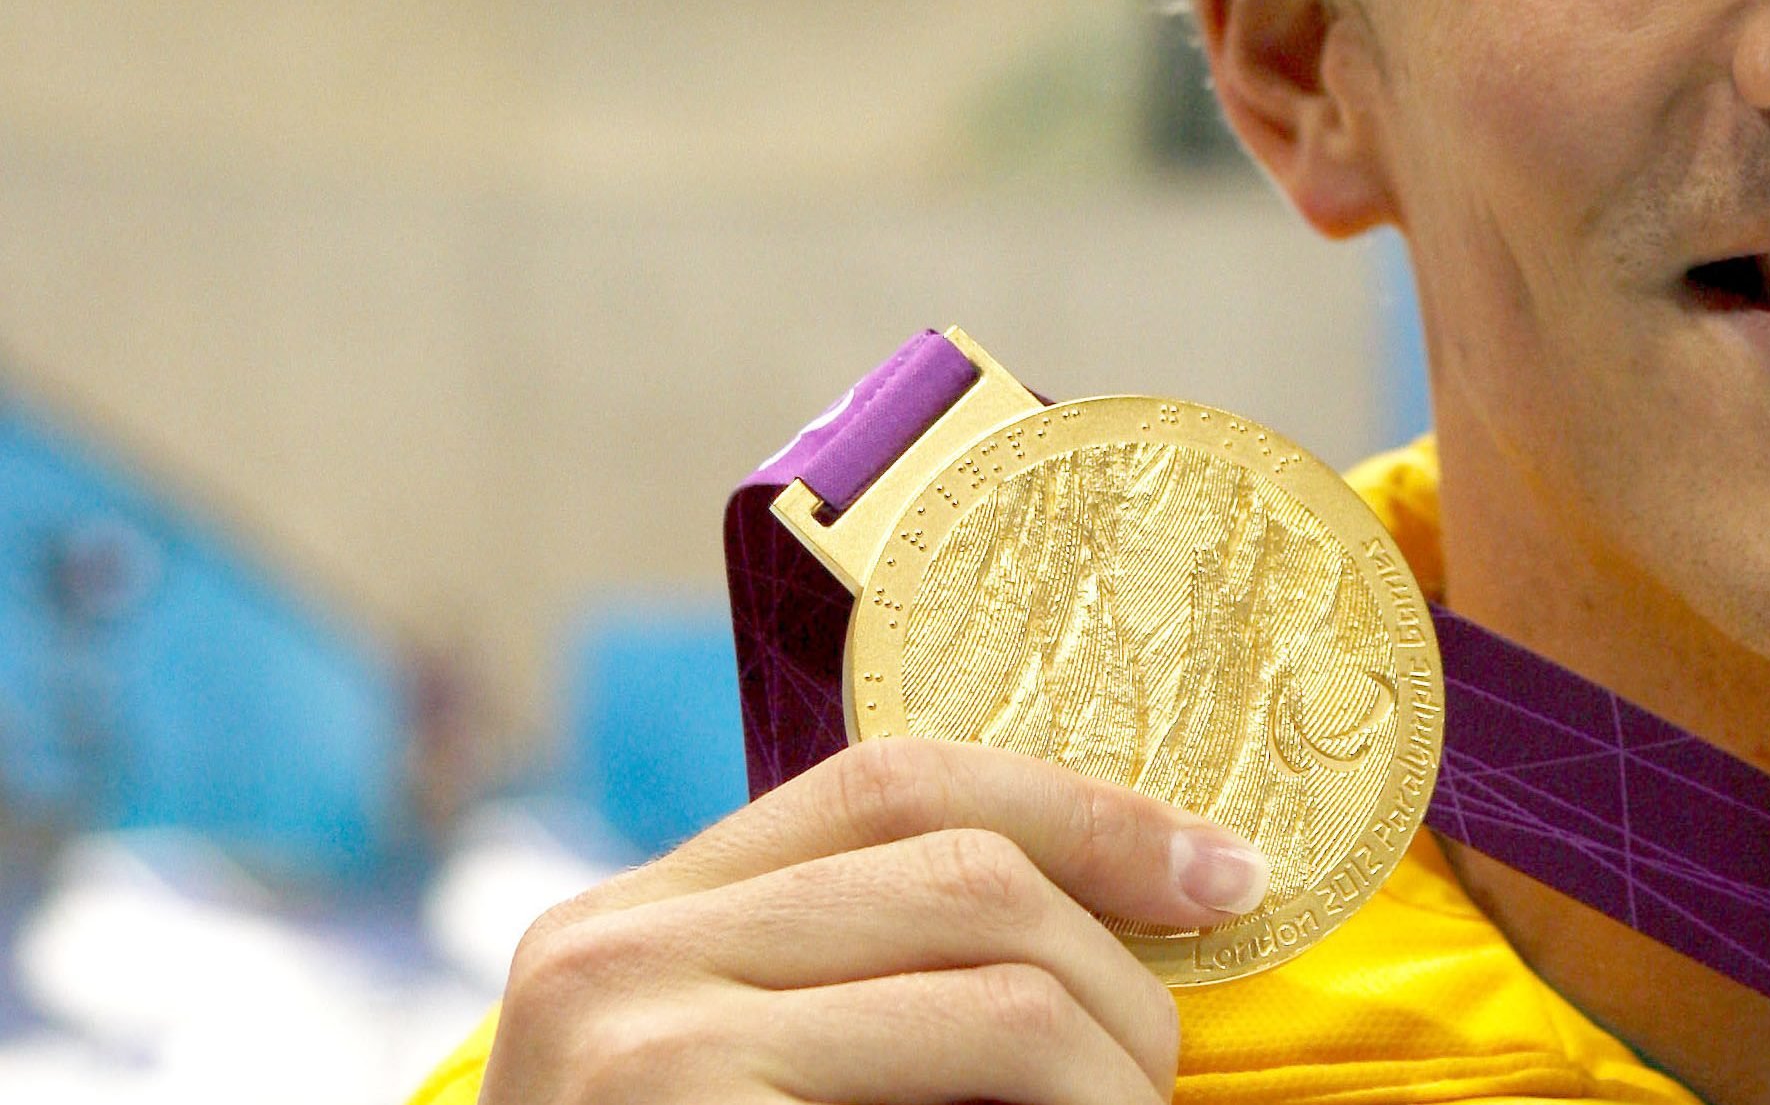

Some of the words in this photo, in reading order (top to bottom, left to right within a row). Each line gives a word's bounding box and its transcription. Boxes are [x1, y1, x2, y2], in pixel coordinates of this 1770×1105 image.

[1363, 538, 1426, 648] Games
[1374, 659, 1440, 851] Paralympic
[1317, 845, 1384, 915] 2012
[1193, 910, 1318, 973] London
